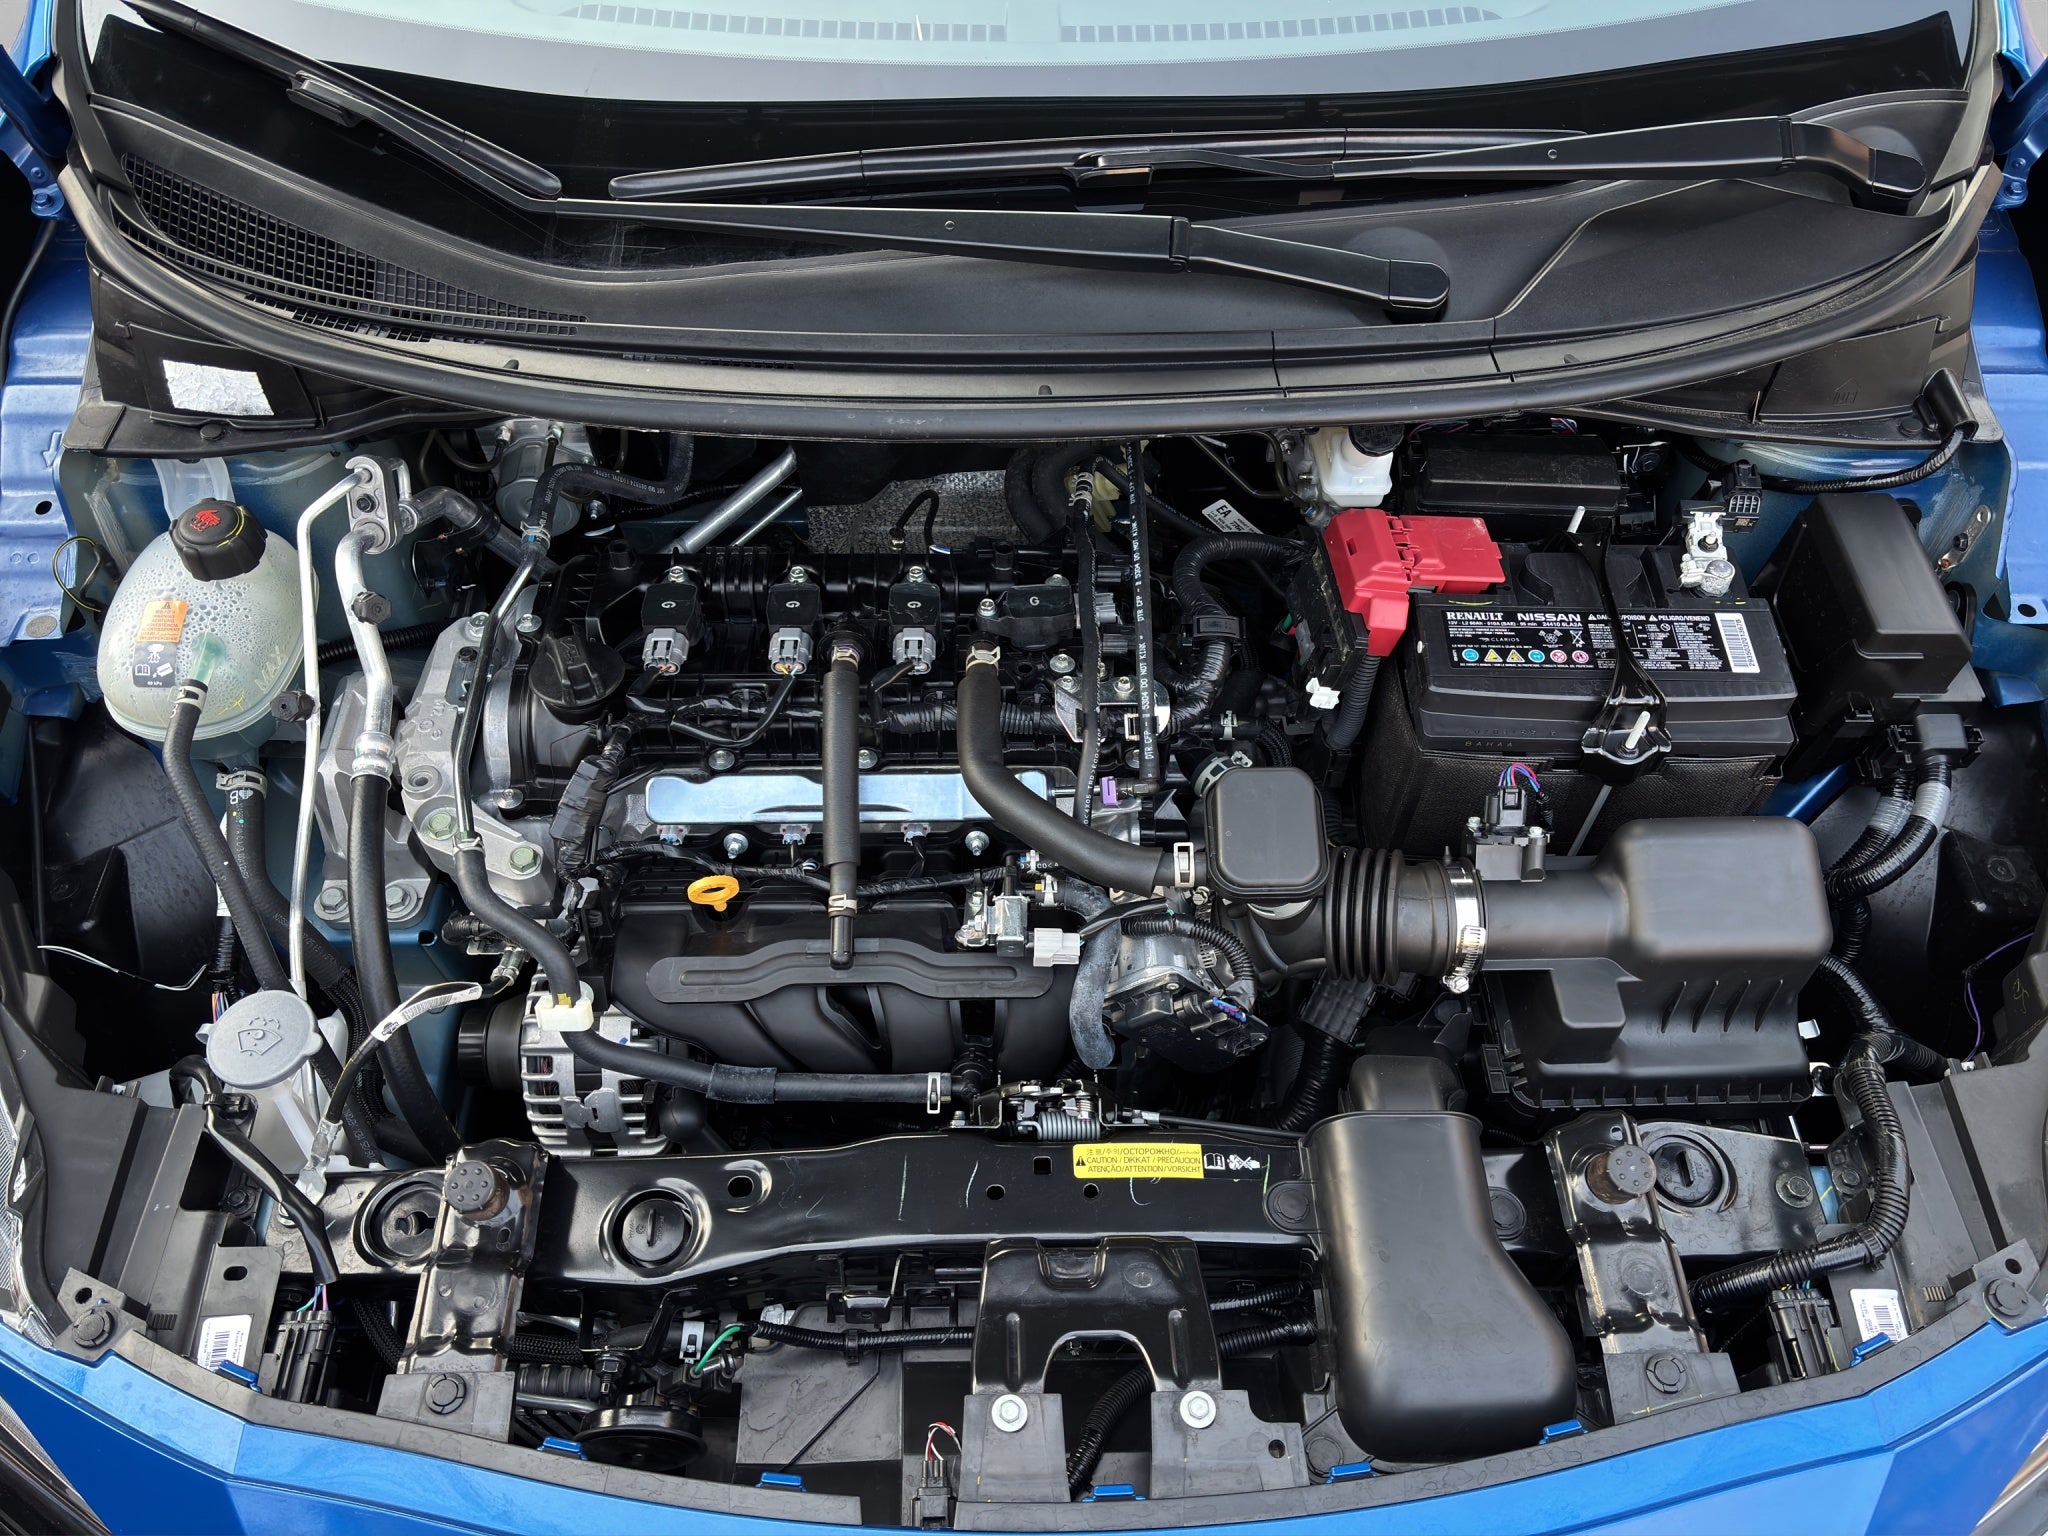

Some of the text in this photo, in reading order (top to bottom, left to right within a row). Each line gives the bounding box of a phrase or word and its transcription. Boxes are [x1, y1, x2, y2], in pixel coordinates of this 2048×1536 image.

[1216, 505, 1232, 518] EA
[1134, 563, 1142, 578] 5304
[1029, 596, 1040, 606] G
[1446, 612, 1581, 622] RENAULT NISSAN
[1142, 678, 1149, 688] DO
[1142, 691, 1150, 710] 5304
[1144, 746, 1154, 760] DTR
[1086, 1156, 1118, 1164] CAUTION
